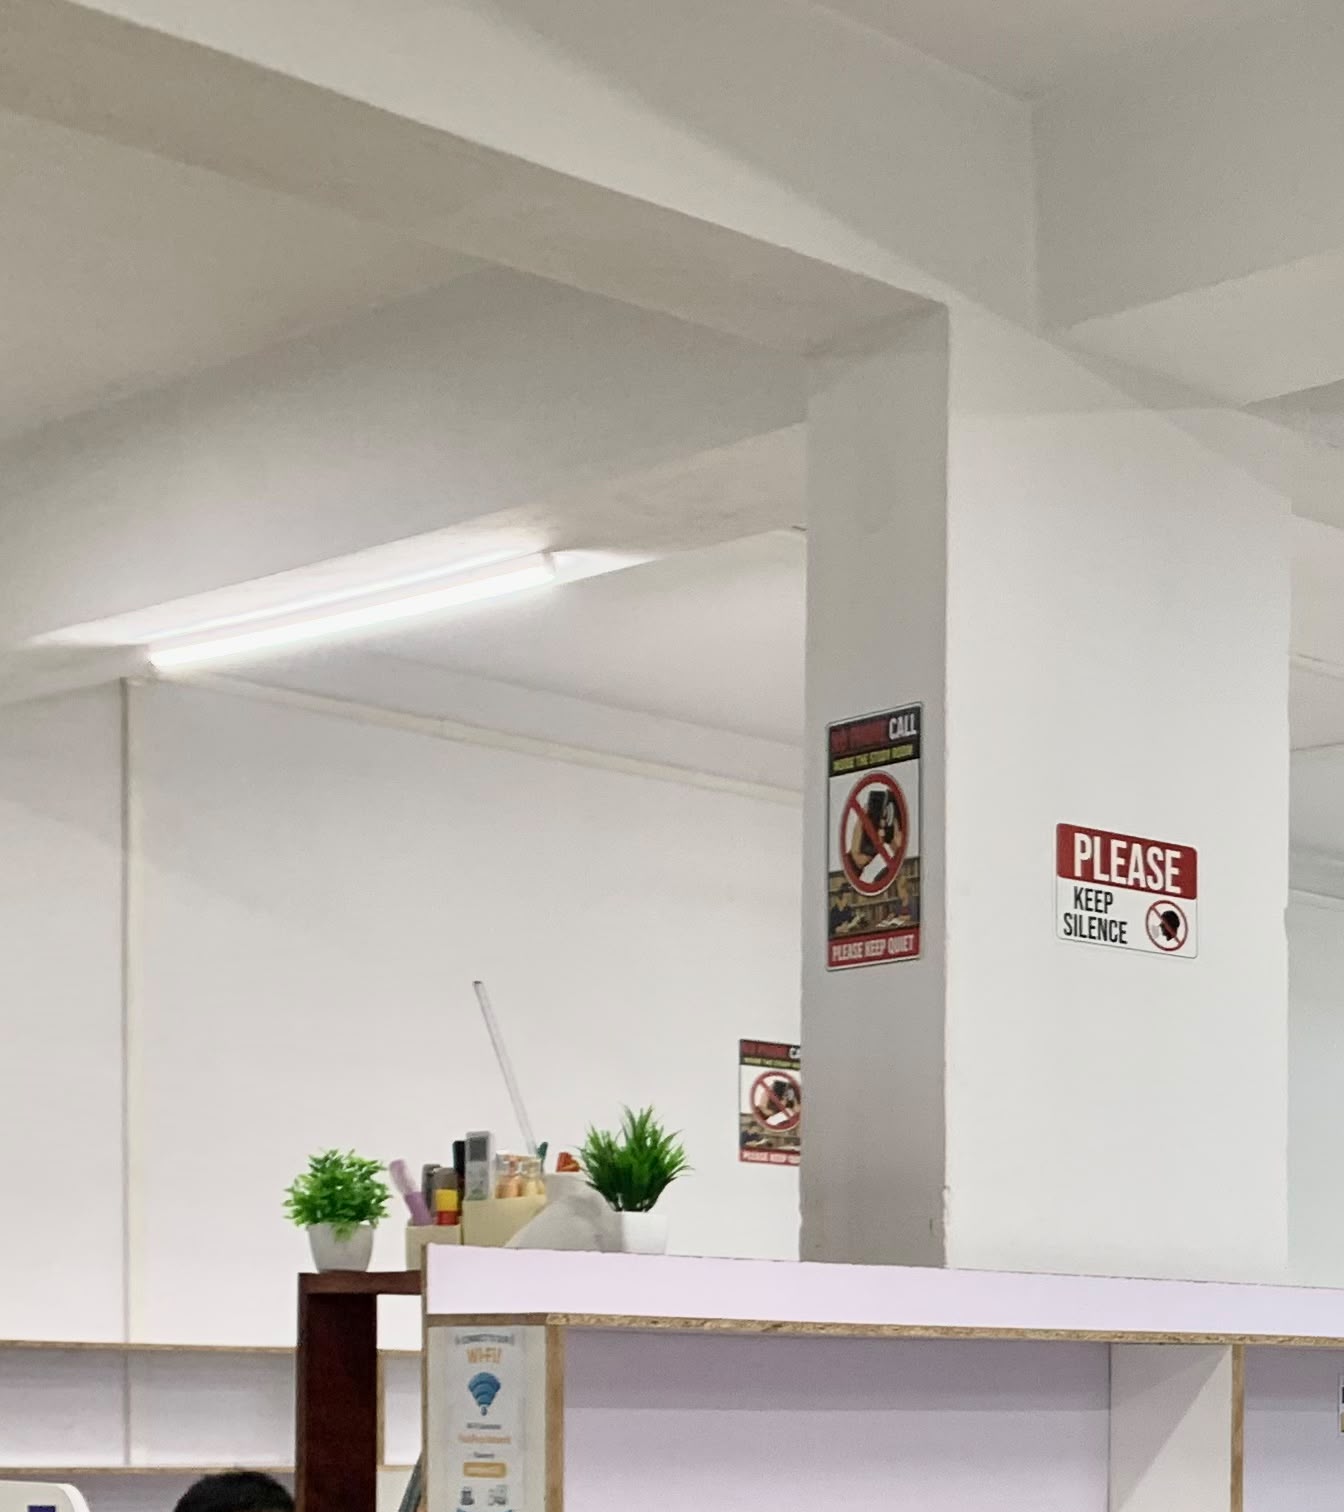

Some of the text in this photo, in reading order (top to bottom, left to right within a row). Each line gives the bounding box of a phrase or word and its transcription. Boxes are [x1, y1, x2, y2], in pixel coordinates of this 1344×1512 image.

[889, 713, 917, 740] CALL
[1074, 832, 1181, 894] PLEASE
[1073, 886, 1114, 914] KEEP
[1063, 912, 1128, 945] SILENCE
[832, 934, 914, 961] PLEASE KEEP QUIET
